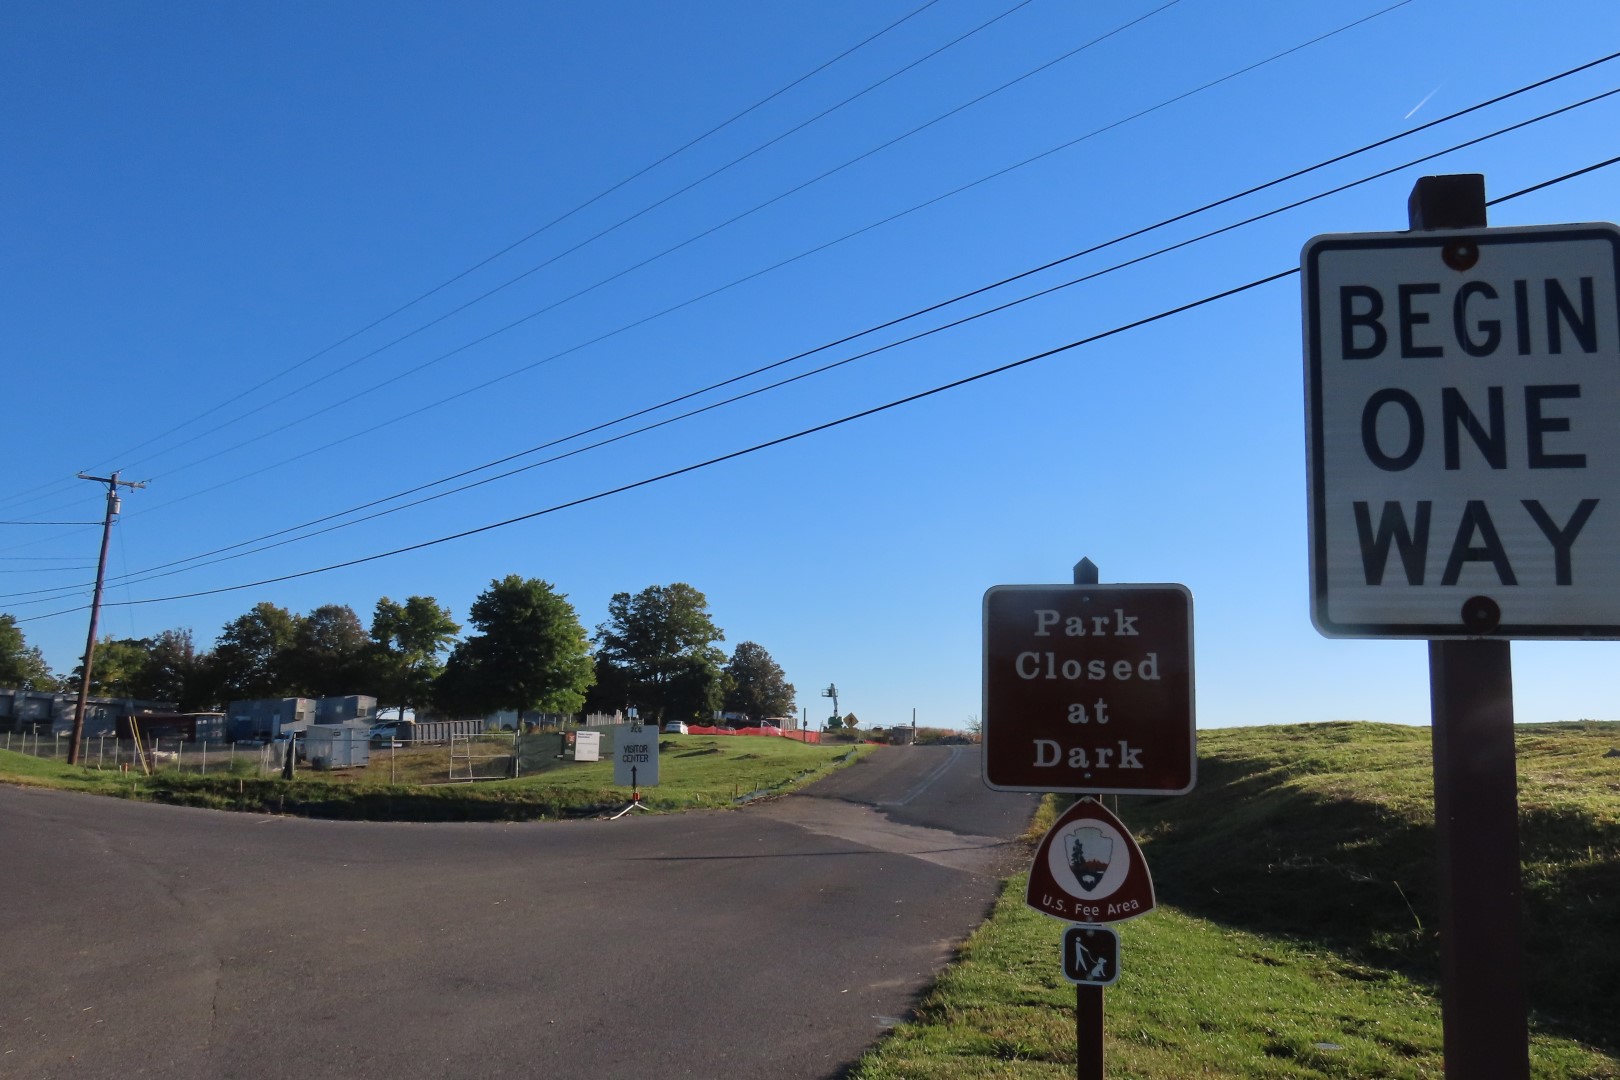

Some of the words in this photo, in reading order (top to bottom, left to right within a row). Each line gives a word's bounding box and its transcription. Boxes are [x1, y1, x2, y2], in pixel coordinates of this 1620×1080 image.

[1340, 276, 1598, 360] BEGIN
[1361, 384, 1587, 472] ONE
[1353, 498, 1600, 586] WAY
[1034, 608, 1139, 637] Park
[1015, 652, 1160, 681] Closed
[1067, 698, 1109, 725] at
[622, 754, 649, 763] CENTER
[623, 744, 648, 753] VISITOR
[1033, 739, 1144, 769] Dark
[1042, 893, 1067, 913] U.S.
[1075, 901, 1099, 916] Fee
[1107, 897, 1139, 916] Area
